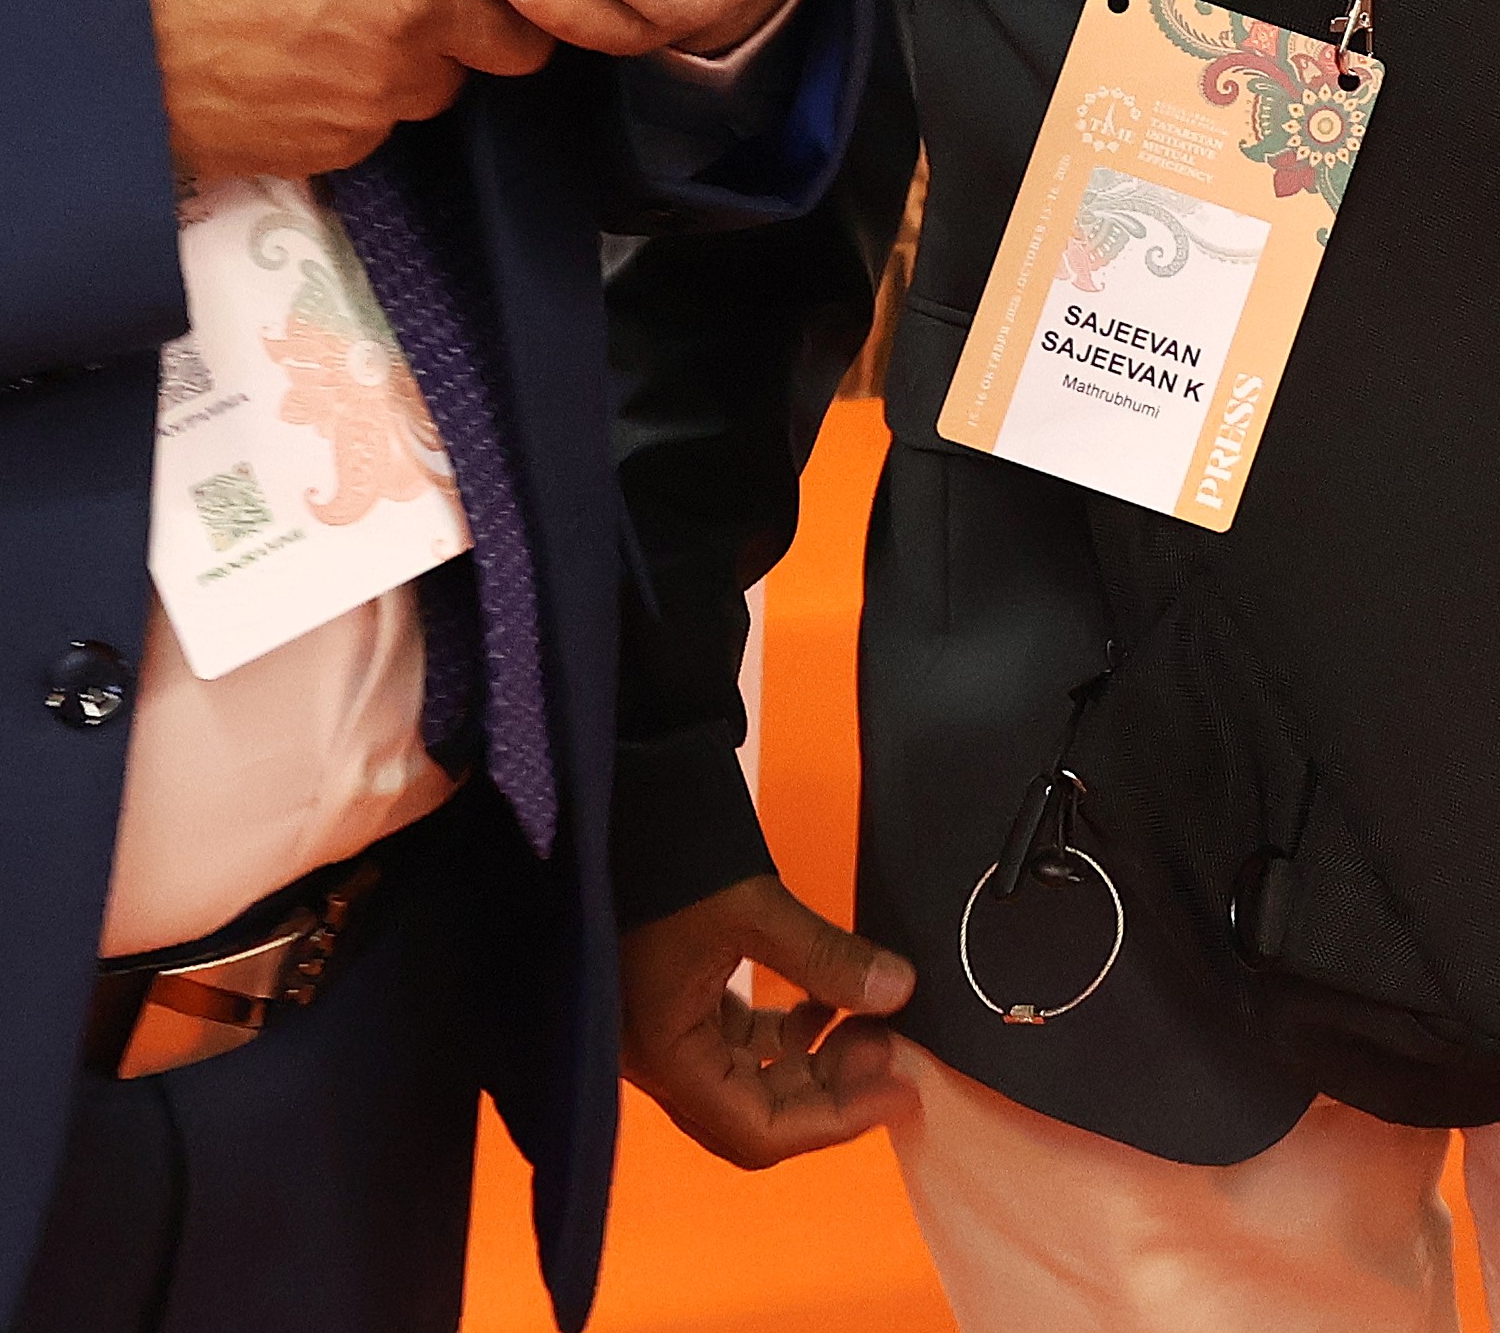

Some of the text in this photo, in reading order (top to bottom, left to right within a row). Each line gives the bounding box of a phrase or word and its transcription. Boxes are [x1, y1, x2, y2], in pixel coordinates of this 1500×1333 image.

[1040, 330, 1206, 403] SAJEEVAN K
[1063, 304, 1202, 368] SAJEEVAN
[1061, 373, 1161, 420] Mathrubhumi
[1194, 372, 1264, 512] PRESS
